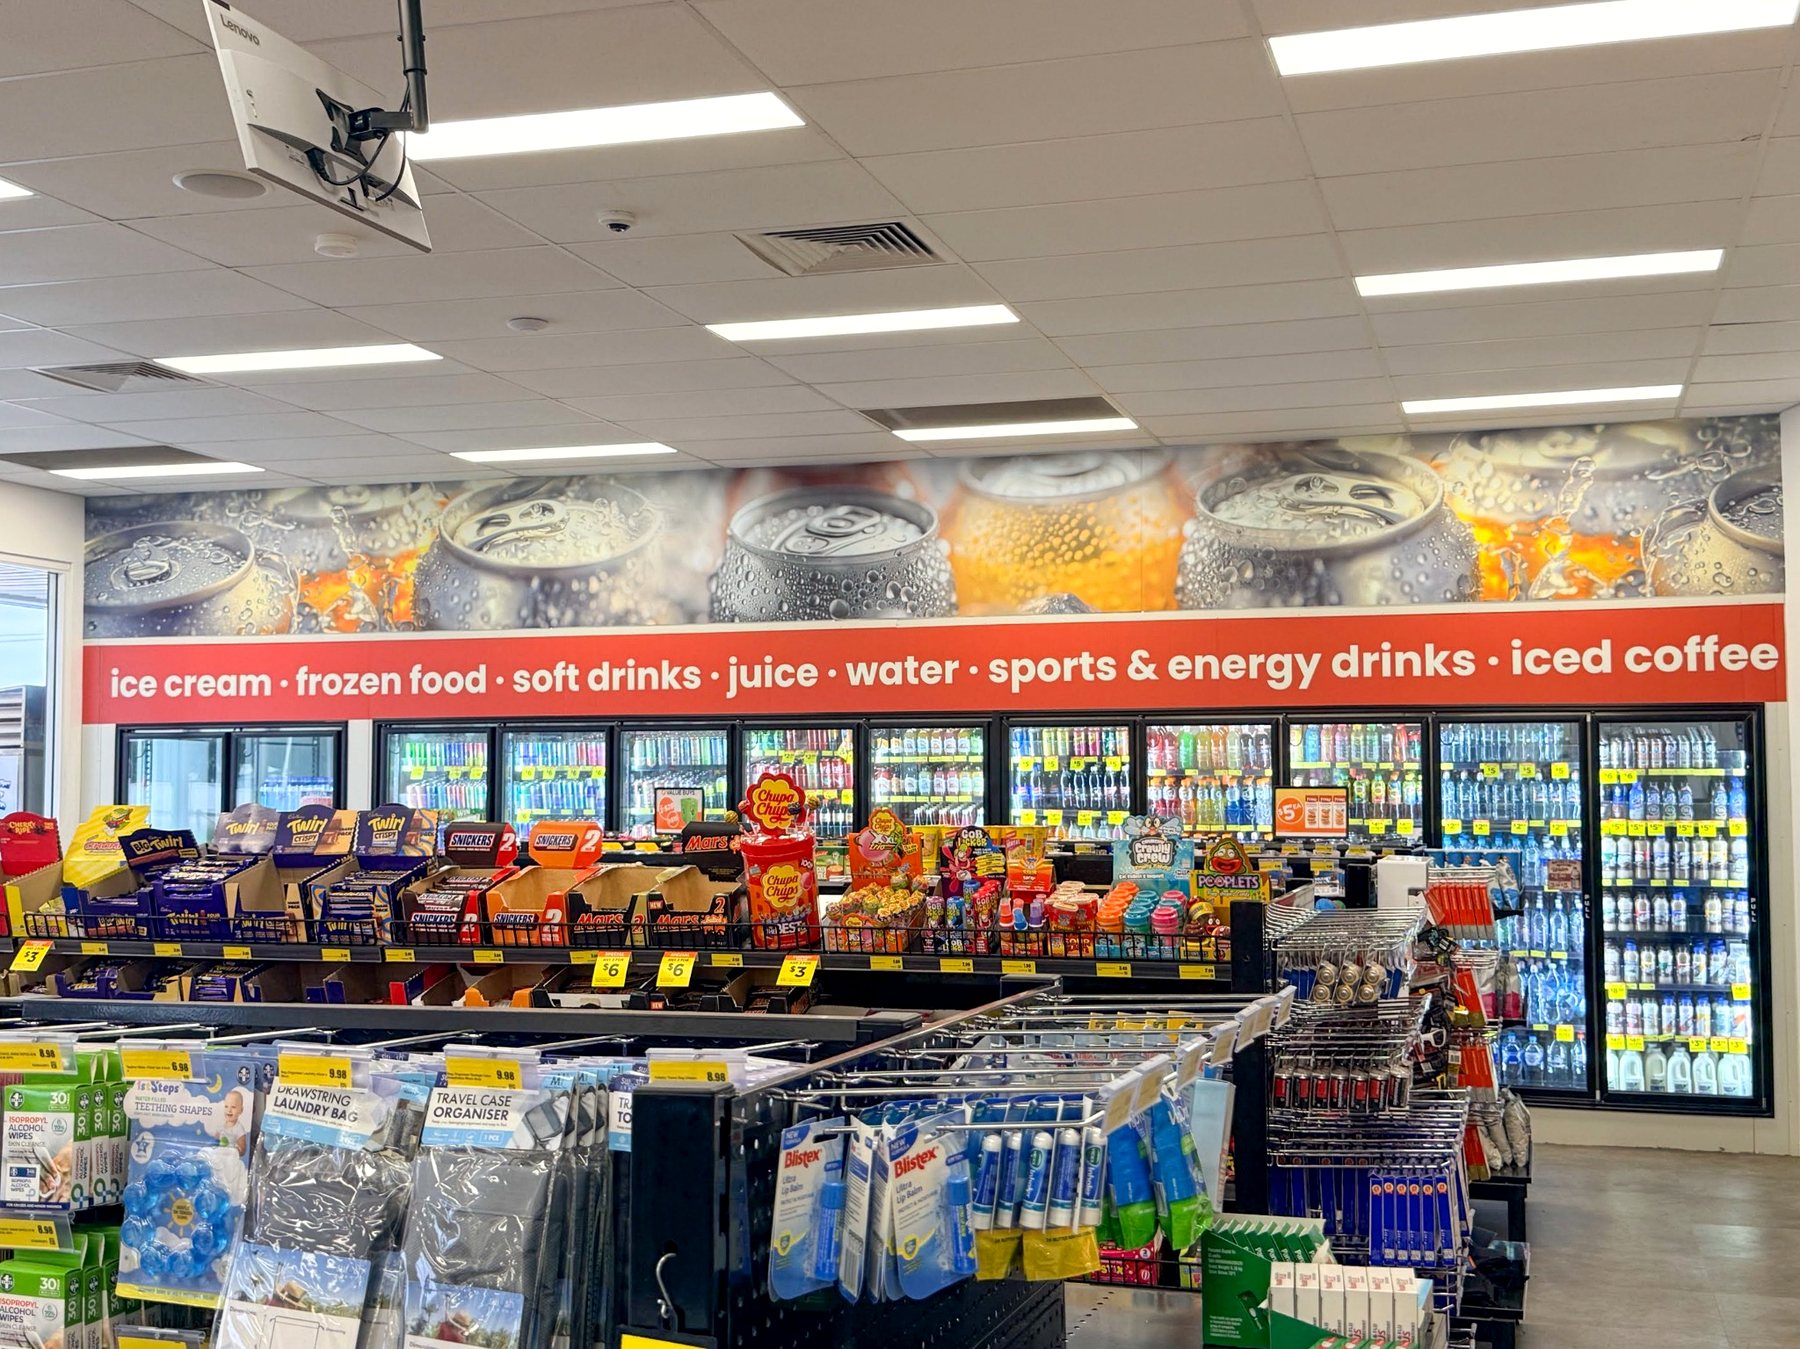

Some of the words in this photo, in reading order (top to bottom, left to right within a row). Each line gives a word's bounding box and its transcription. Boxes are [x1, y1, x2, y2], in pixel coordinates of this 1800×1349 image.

[220, 14, 260, 46] Lenovo
[110, 668, 158, 698] ice
[165, 675, 271, 698] cream
[295, 666, 401, 696] frozen
[410, 664, 486, 694] food
[513, 661, 579, 692] soft
[588, 659, 701, 691] drinks
[724, 656, 818, 698] juice
[846, 656, 959, 685] water
[989, 652, 1116, 693] sports
[1127, 650, 1158, 680] &
[1168, 654, 1321, 689] energy
[1332, 642, 1475, 677] drinks
[1512, 639, 1611, 674] iced
[1625, 637, 1779, 671] coffee
[758, 789, 795, 806] Chupa
[756, 802, 790, 823] Chup
[1278, 804, 1295, 821] $5
[9, 821, 36, 829] CHERRY
[226, 818, 260, 836] Twirl
[287, 815, 329, 834] Twirl
[368, 813, 406, 832] Twirl
[151, 834, 183, 851] Twirl
[451, 833, 494, 846] SNICKERS
[500, 832, 515, 852] 2
[536, 834, 574, 845] SNICKERS
[580, 830, 601, 853] 2
[686, 834, 729, 851] Mars
[1135, 842, 1171, 854] Crawly
[1136, 852, 1170, 864] Crew
[767, 875, 799, 888] Chupa
[1197, 875, 1259, 889] POOPLETS
[766, 885, 799, 903] Chups
[714, 897, 726, 914] 2
[493, 913, 534, 925] SNICKERS
[24, 951, 40, 963] $3
[603, 962, 620, 977] $6
[667, 962, 685, 977] $6
[789, 965, 807, 978] $3
[38, 1048, 56, 1059] 8.98
[171, 1062, 189, 1072] 6.98
[329, 1068, 347, 1080] 9.98
[496, 1069, 515, 1081] 9.98
[706, 1071, 726, 1082] 8.98
[136, 1080, 151, 1091] 1st
[151, 1080, 180, 1095] Steps
[50, 1091, 67, 1105] 30
[277, 1086, 352, 1107] DRAWSTRING
[436, 1092, 477, 1106] TRAVEL
[480, 1094, 512, 1108] CASE
[135, 1101, 178, 1114] TEETHING
[179, 1105, 213, 1117] SHAPES
[273, 1096, 330, 1117] LAUNDRY
[330, 1106, 359, 1123] BAG
[433, 1106, 509, 1122] ORGANISER
[9, 1115, 48, 1124] ISOPROPYL
[8, 1124, 45, 1132] ALCOHOL
[8, 1132, 33, 1140] WIPES
[890, 1137, 906, 1149] NEW
[784, 1148, 821, 1169] Blistex
[894, 1146, 938, 1179] Blistex
[895, 1181, 913, 1194] Ultra
[906, 1186, 923, 1200] Balm
[37, 1224, 54, 1235] 8.98
[40, 1277, 57, 1290] 30
[0, 1306, 36, 1317] ALCOHOL
[0, 1313, 24, 1323] WIPES
